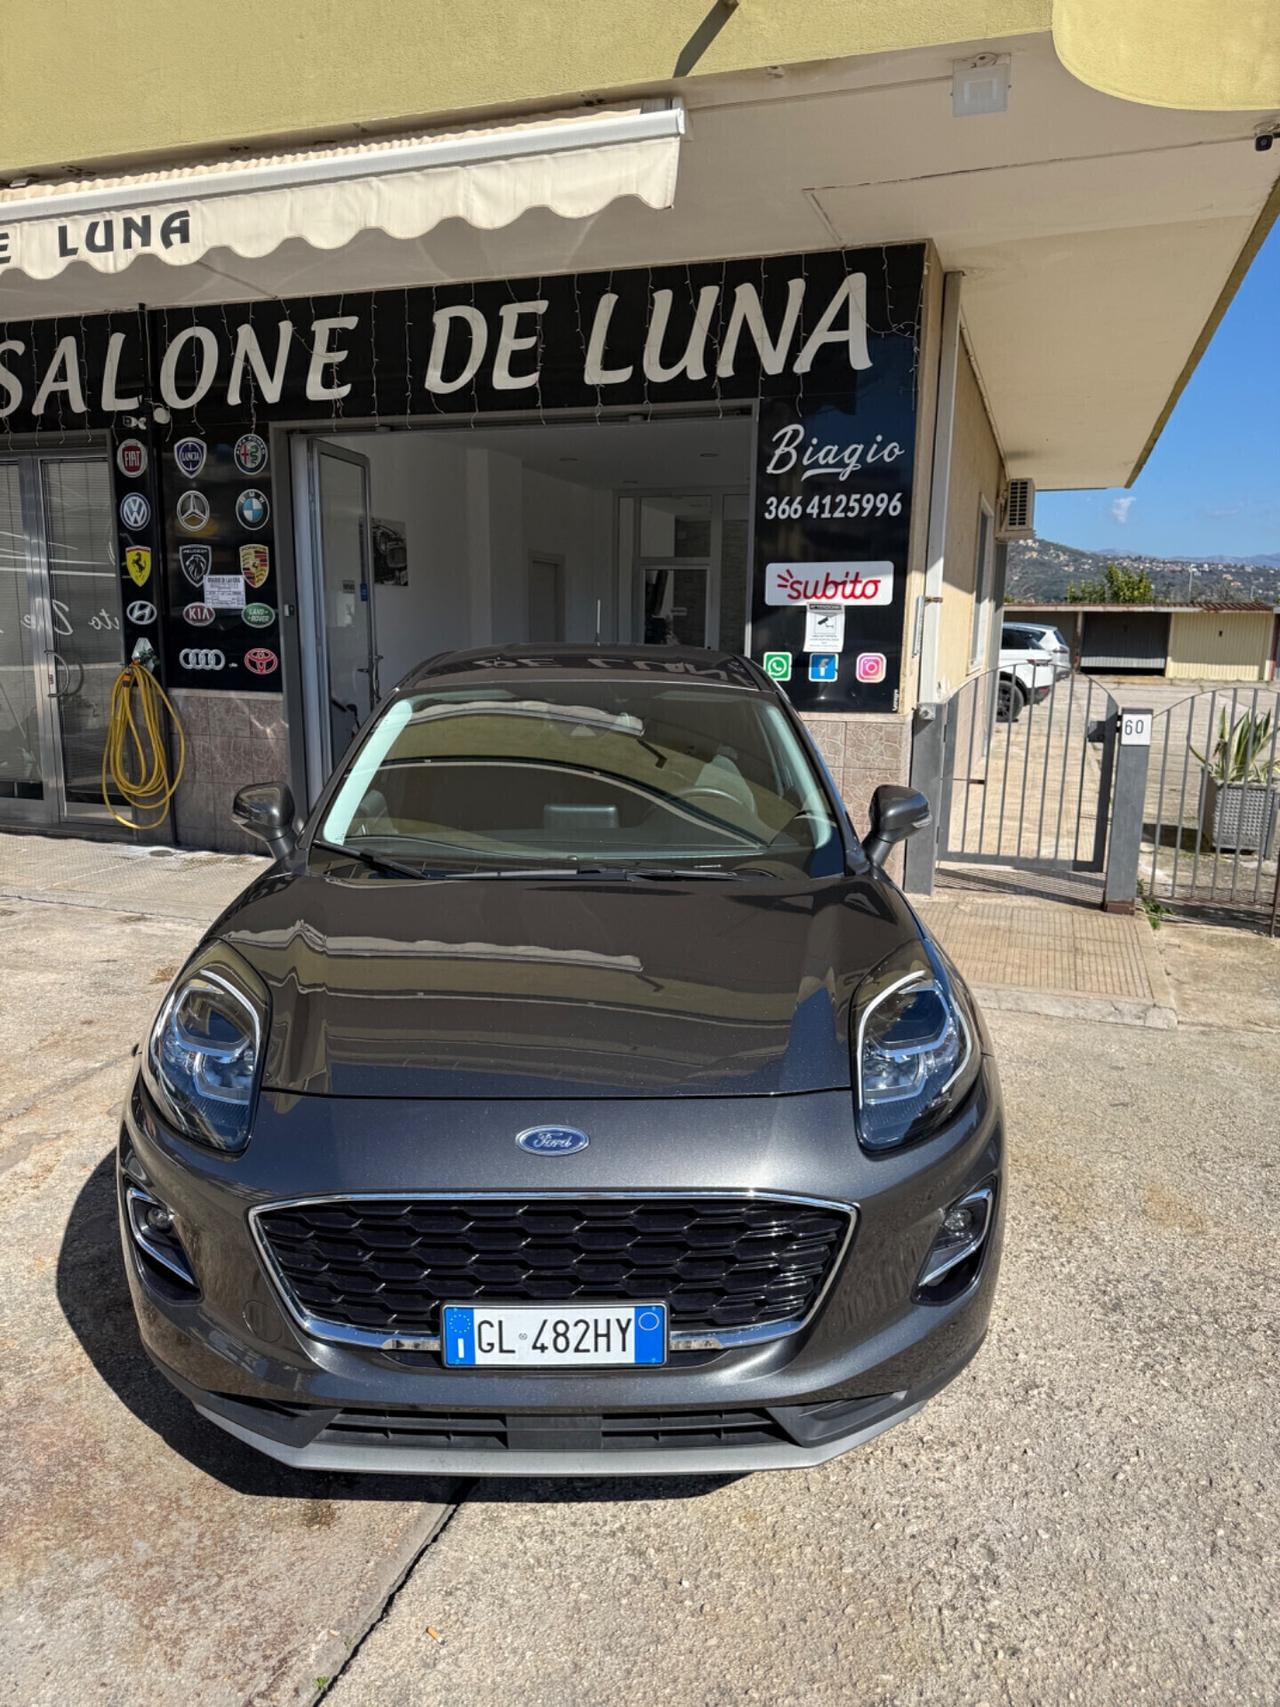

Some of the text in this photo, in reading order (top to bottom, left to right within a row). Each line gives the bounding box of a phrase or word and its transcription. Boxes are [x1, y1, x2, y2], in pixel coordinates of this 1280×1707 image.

[58, 210, 190, 258] LUNA
[0, 272, 873, 418] SALONE DE LUNA
[124, 450, 141, 467] FIAT
[766, 424, 905, 481] Biagio
[765, 492, 903, 519] 366 4125996
[787, 571, 881, 600] subito
[188, 610, 210, 620] KIA
[1124, 719, 1145, 736] 60
[532, 1131, 573, 1148] Ford
[477, 1319, 516, 1354] GL
[531, 1318, 633, 1354] 482HY
